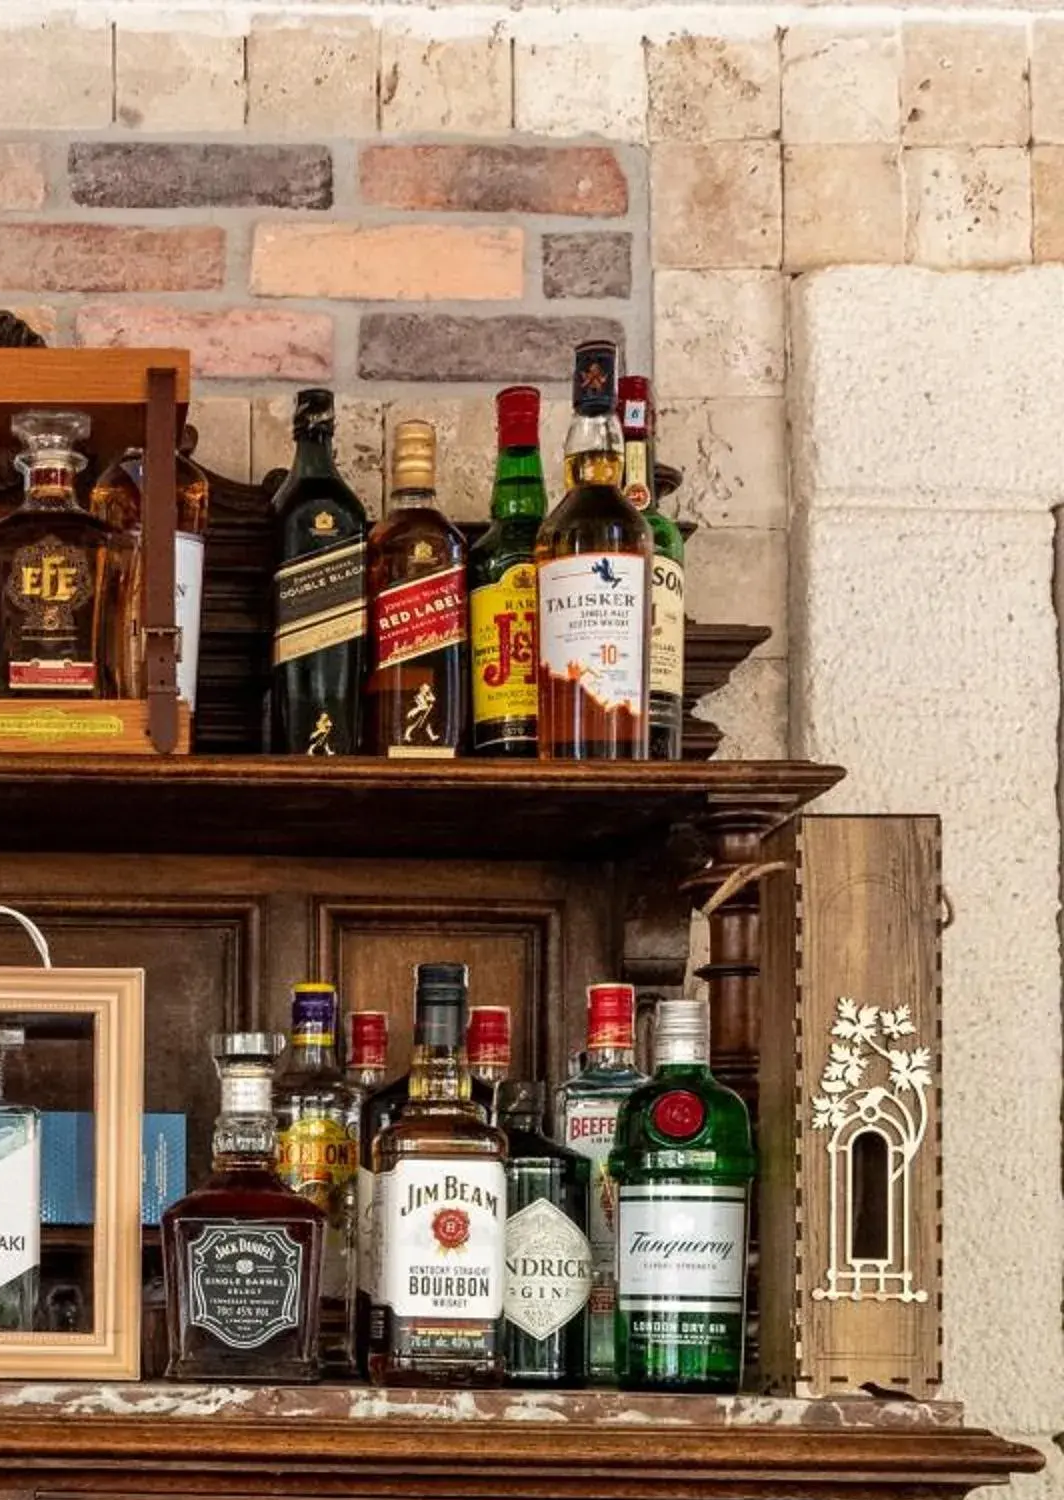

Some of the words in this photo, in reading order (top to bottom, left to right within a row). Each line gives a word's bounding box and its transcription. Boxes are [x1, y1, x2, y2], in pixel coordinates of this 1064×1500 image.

[279, 577, 327, 600] DOUBLE
[379, 611, 412, 631] RED
[415, 593, 464, 619] LABEL
[505, 599, 537, 611] RAR
[546, 592, 636, 614] TALISKER
[599, 643, 618, 666] 10
[570, 1116, 617, 1141] BEEFE
[400, 1183, 439, 1217] JIM
[444, 1175, 499, 1217] BEAM
[629, 1230, 736, 1262] Tanqueray
[408, 1265, 450, 1275] KENTUCKY
[408, 1275, 490, 1297] BOURBON
[520, 1285, 562, 1299] GIN
